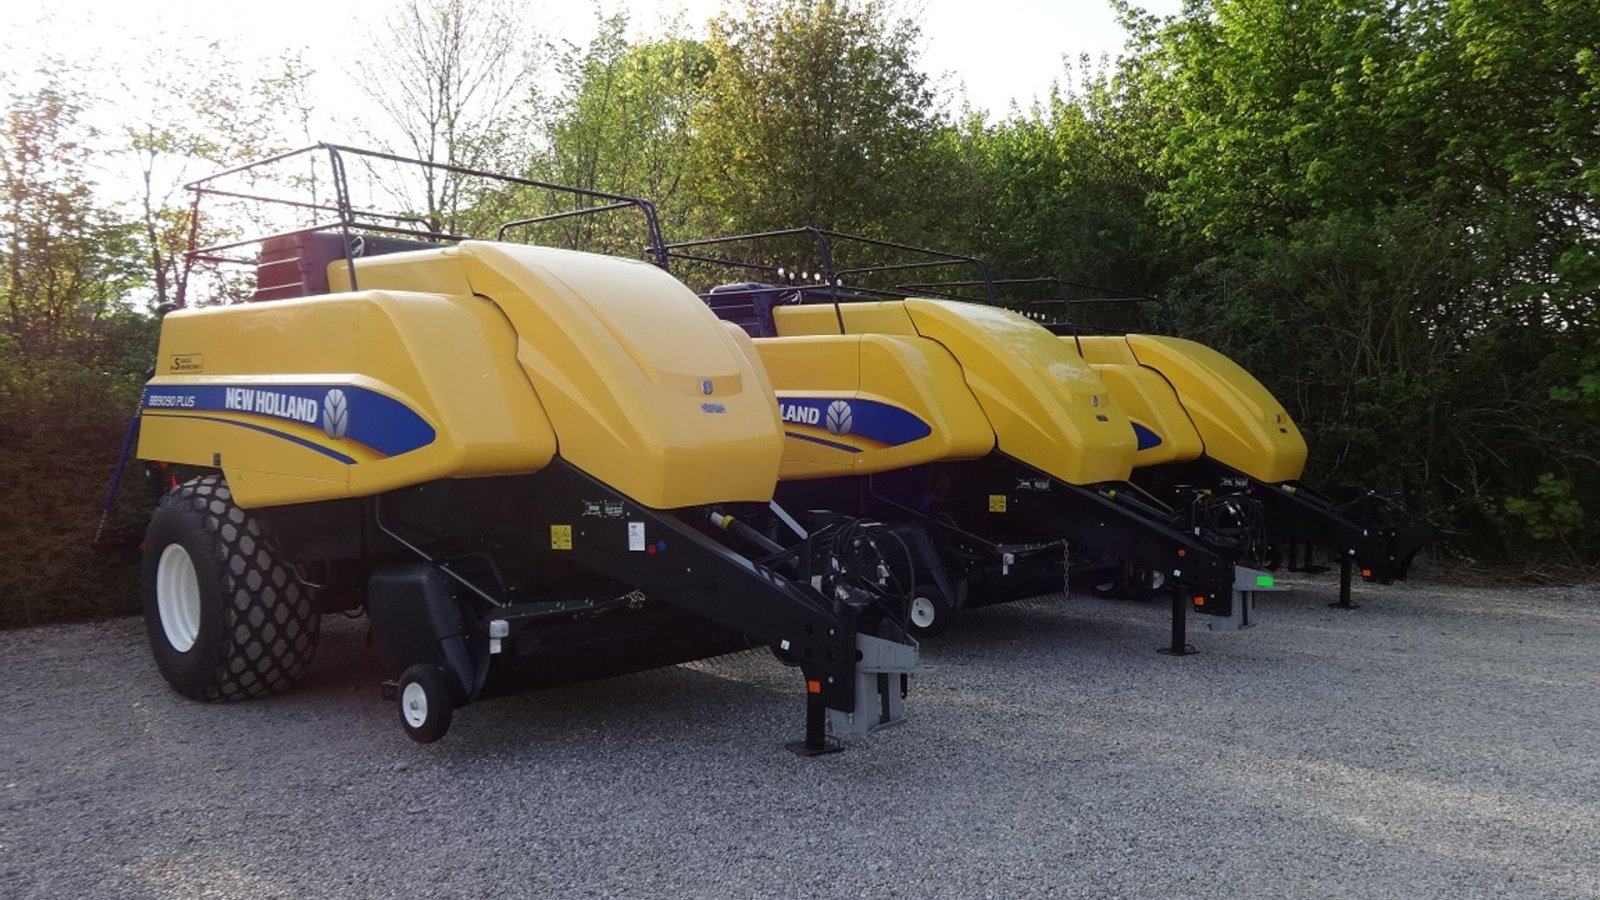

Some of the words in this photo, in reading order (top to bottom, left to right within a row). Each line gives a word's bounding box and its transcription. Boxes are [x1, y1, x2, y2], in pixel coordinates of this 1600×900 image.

[176, 396, 196, 407] PLUS
[225, 387, 254, 411] NEW
[255, 390, 318, 423] HOLLAND
[780, 404, 820, 424] LAND
